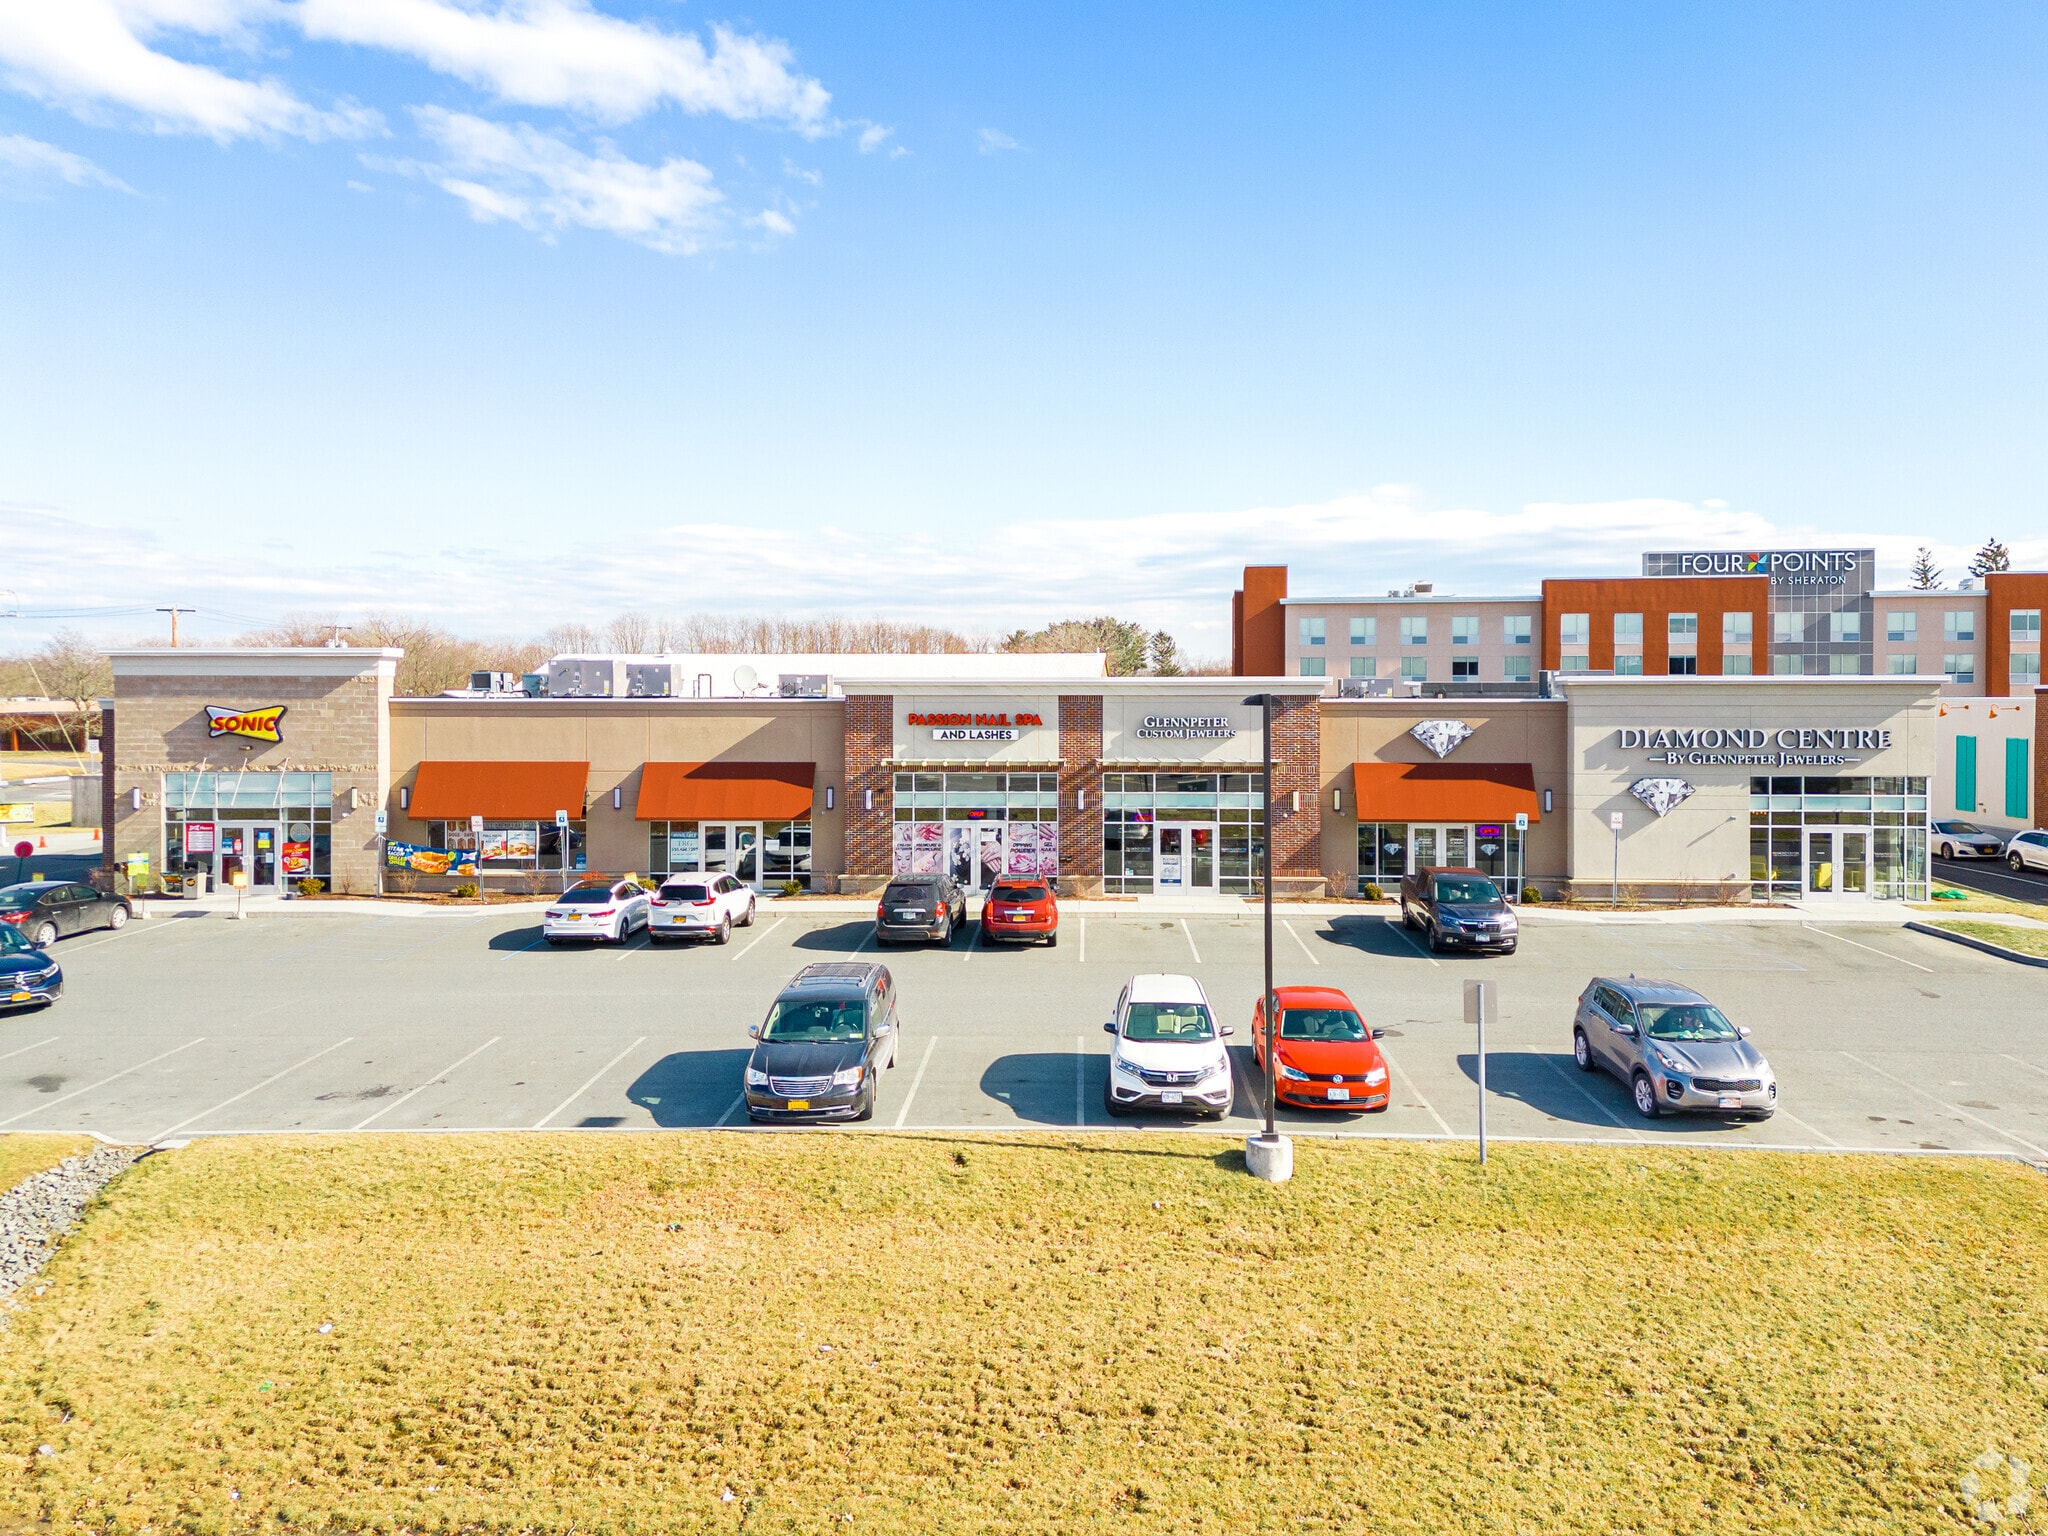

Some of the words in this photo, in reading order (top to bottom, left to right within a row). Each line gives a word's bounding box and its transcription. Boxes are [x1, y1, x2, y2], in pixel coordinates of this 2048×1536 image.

[1681, 554, 1745, 573] FOUR
[1771, 552, 1857, 572] POINTS
[1771, 576, 1784, 585] BY
[1788, 575, 1846, 585] SHERATON
[213, 716, 279, 732] SONIC
[908, 713, 972, 726] PASSION
[975, 713, 1011, 726] NAIL
[1015, 713, 1043, 726] SPA
[1143, 715, 1229, 728] GLENNPETER
[940, 730, 966, 740] AND
[969, 730, 1012, 740] LASHES
[1136, 728, 1183, 739] CUSTOM
[1184, 728, 1237, 741] JEWELERS
[1618, 729, 1769, 750] DIAMOND
[1775, 729, 1893, 750] CENTRE
[1689, 752, 1776, 765] GLENNPETER
[1778, 752, 1845, 768] JEWELERS
